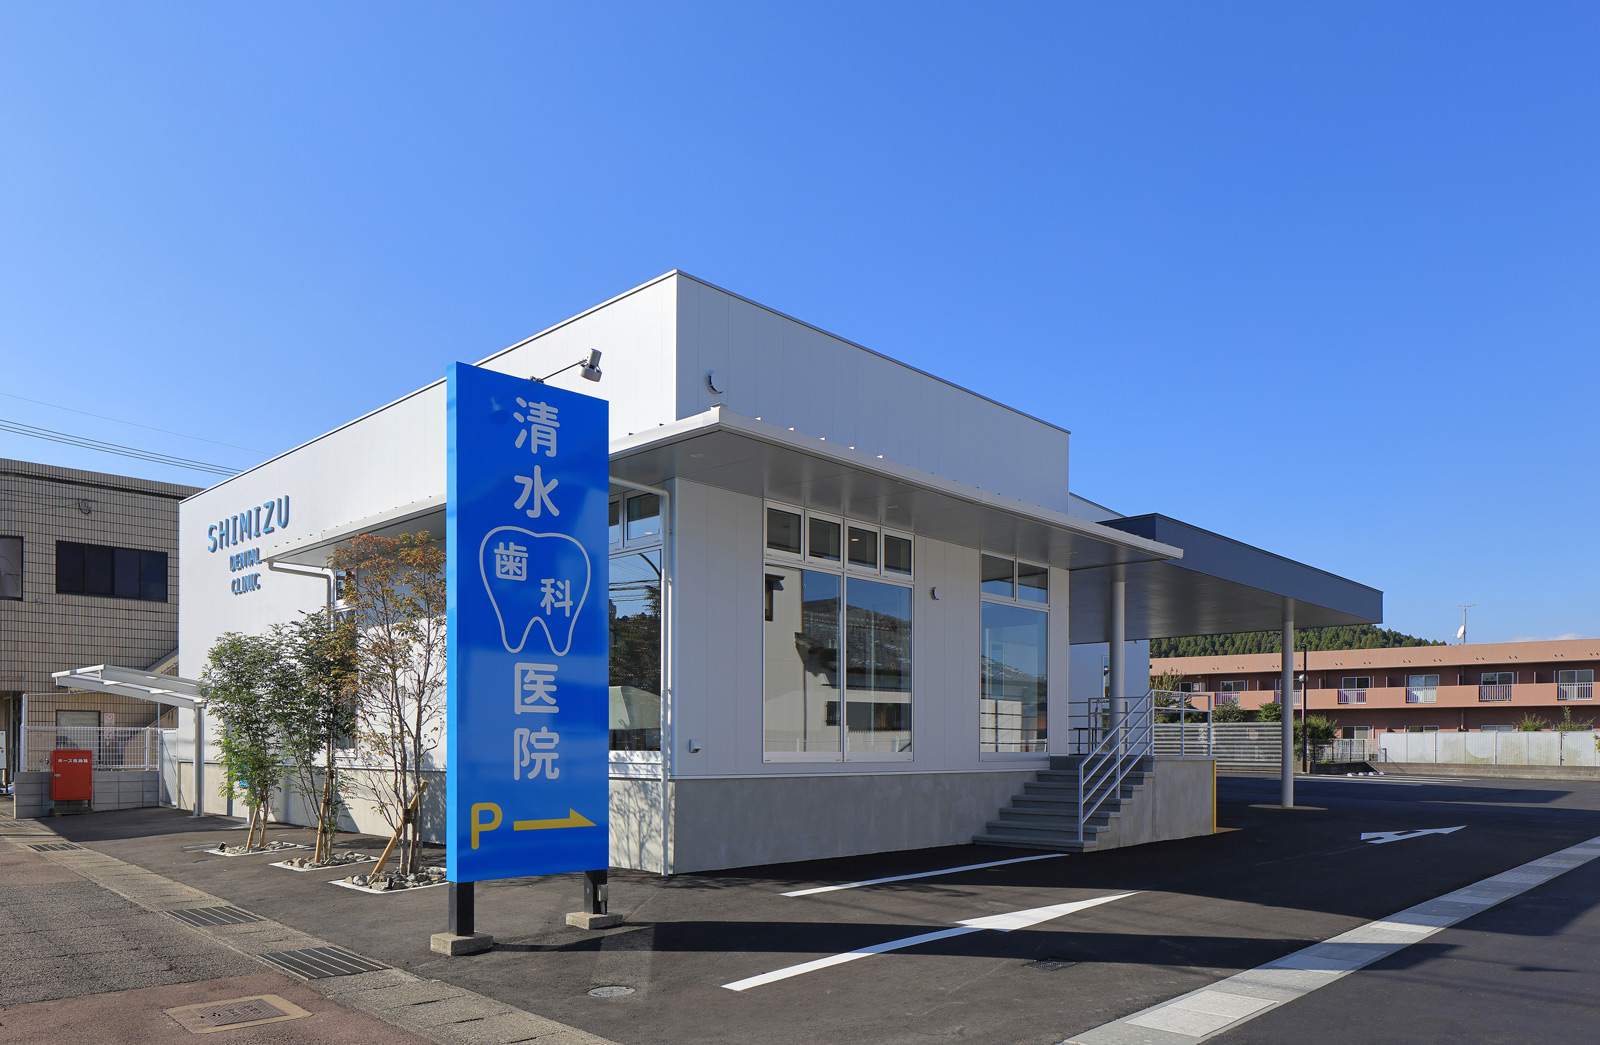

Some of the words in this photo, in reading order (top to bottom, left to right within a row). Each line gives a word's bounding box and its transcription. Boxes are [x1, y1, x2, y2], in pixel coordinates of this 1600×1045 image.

[208, 495, 289, 553] SHIMIZU
[229, 547, 261, 572] DENTAL
[231, 573, 261, 595] CLINIC
[471, 803, 502, 850] P
